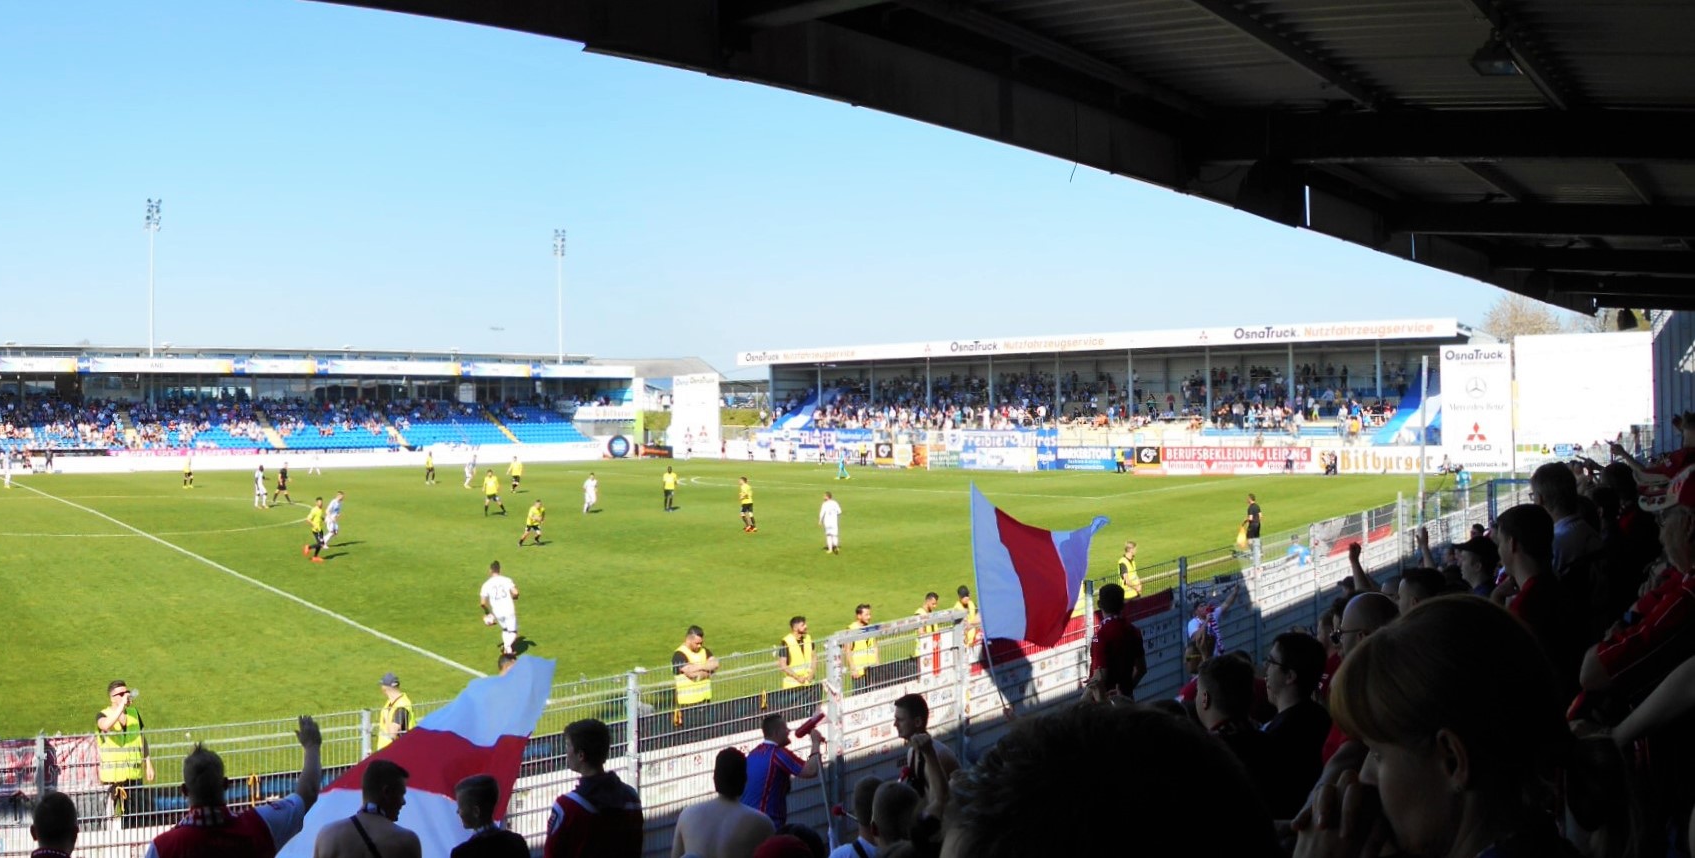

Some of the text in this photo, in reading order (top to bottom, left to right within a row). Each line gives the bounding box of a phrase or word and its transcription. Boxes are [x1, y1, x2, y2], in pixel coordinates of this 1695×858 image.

[1304, 322, 1435, 338] Nutzfahrzeugservice
[1003, 336, 1105, 351] Nutzfahrzeugservice
[1166, 448, 1264, 460] BERUFSBEKLEIDUNG
[1462, 443, 1492, 451] FUSO
[491, 584, 508, 600] 23
